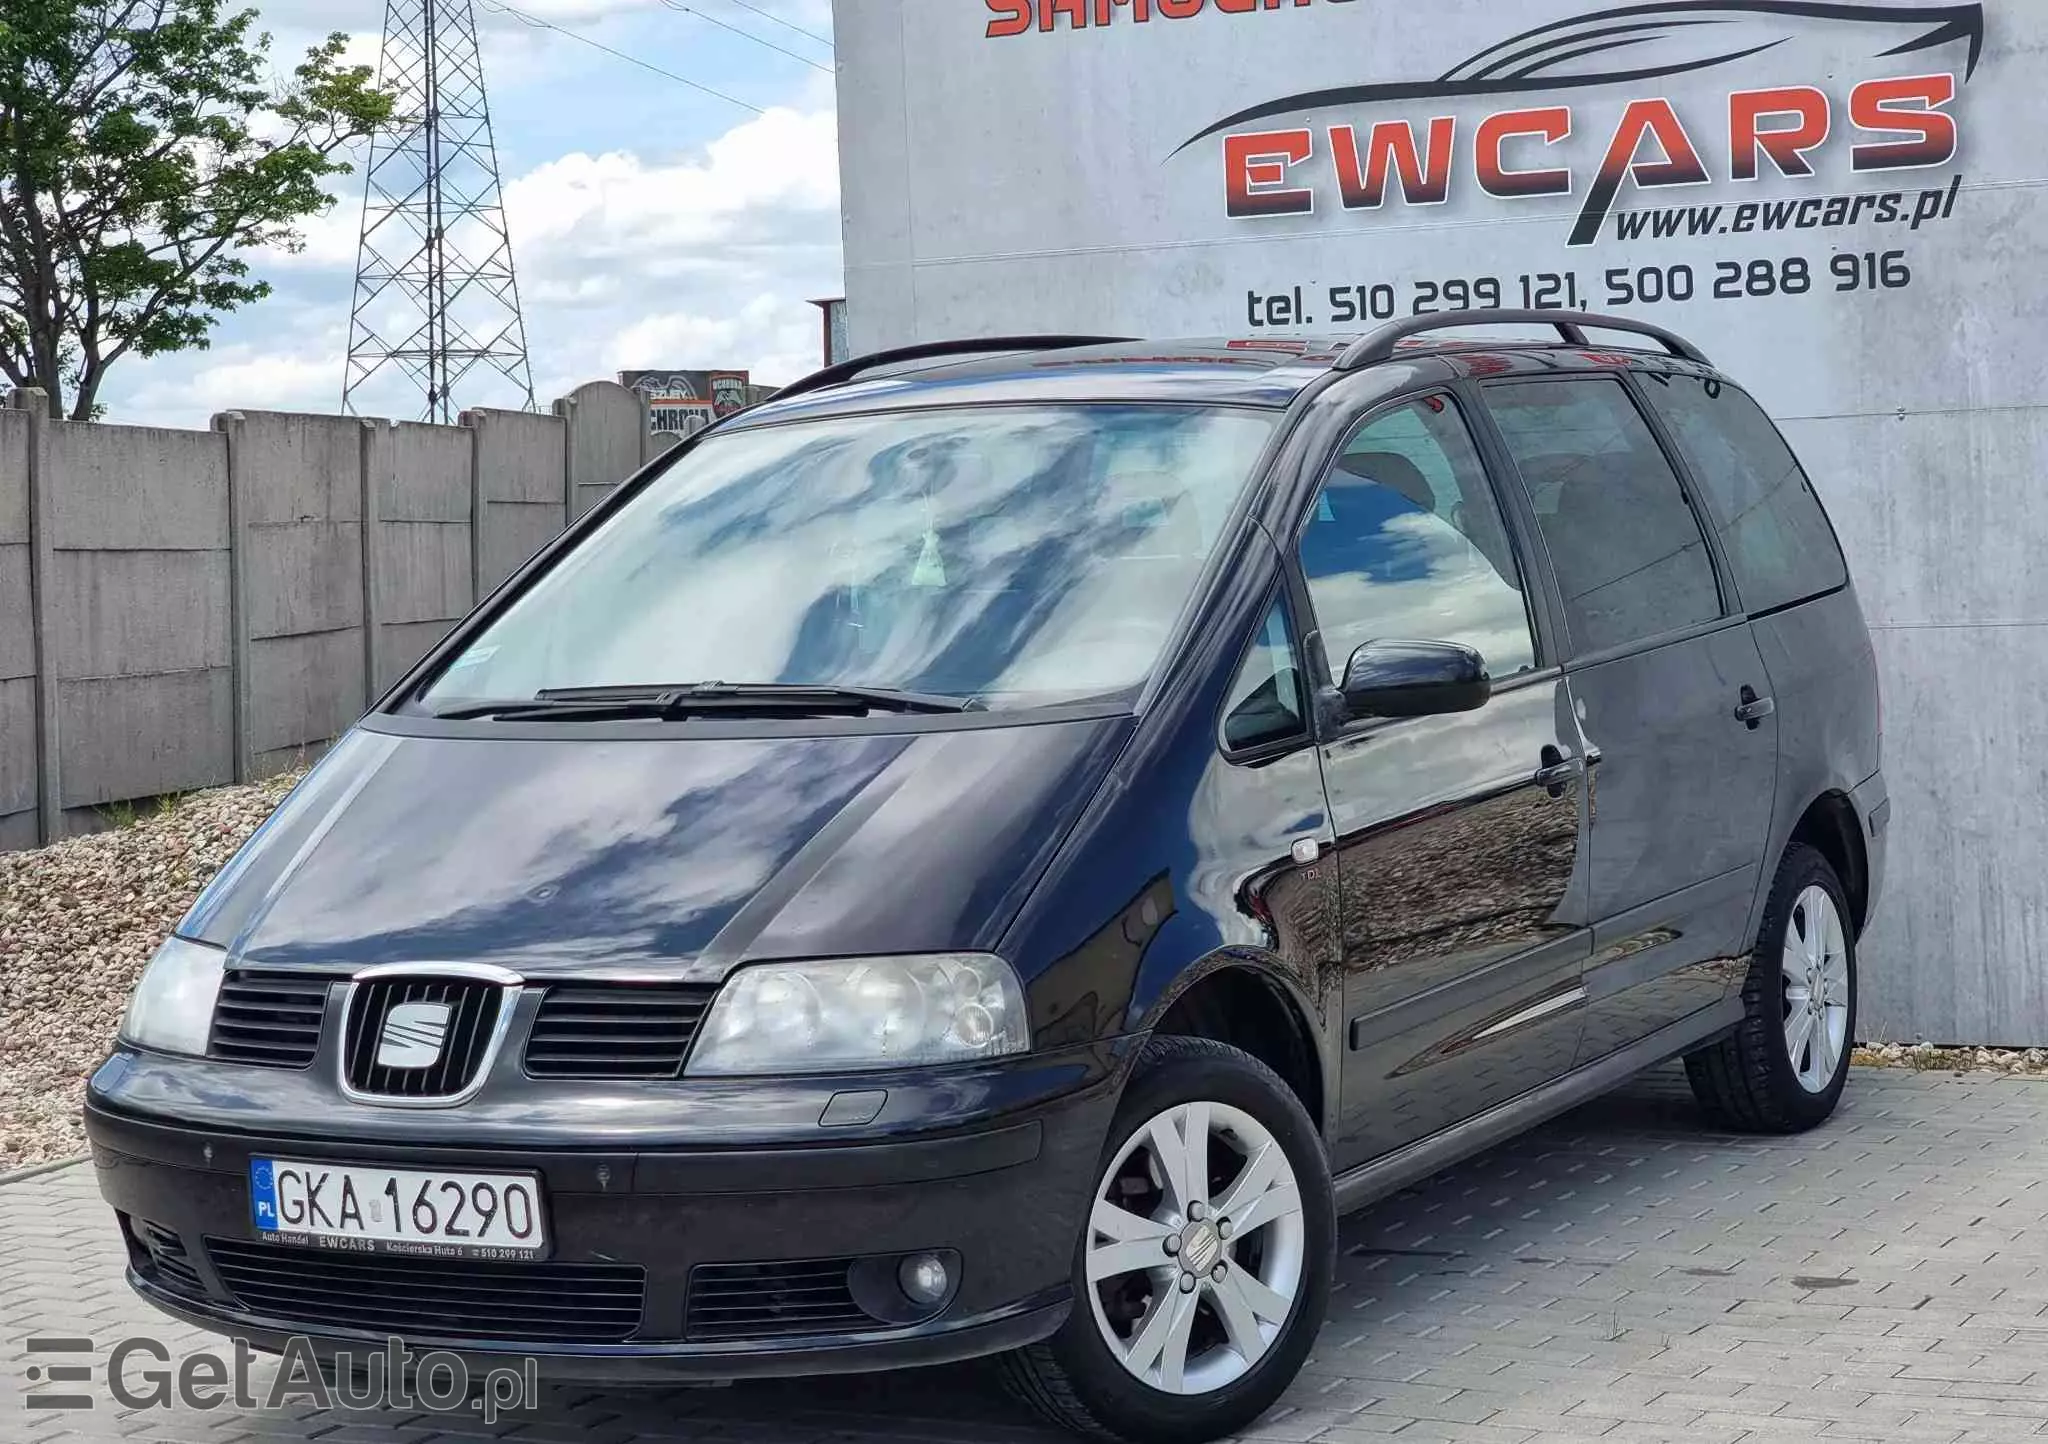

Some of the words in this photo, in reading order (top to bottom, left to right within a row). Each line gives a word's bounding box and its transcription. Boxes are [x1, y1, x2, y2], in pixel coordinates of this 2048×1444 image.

[1225, 73, 1957, 247] EWCARS
[1617, 174, 1962, 241] www.ewcars.pl
[1247, 285, 1313, 327] tel.
[1329, 283, 1395, 323] 510
[1412, 276, 1501, 316] 299
[1519, 271, 1588, 313] 121,
[1605, 265, 1694, 306] 500
[1713, 257, 1811, 299] 288
[1830, 250, 1911, 292] 916
[258, 1201, 275, 1217] PL
[278, 1168, 365, 1231] GKA
[384, 1176, 533, 1239] 16290
[262, 1231, 280, 1242] Auto
[319, 1235, 375, 1251] EWCARS
